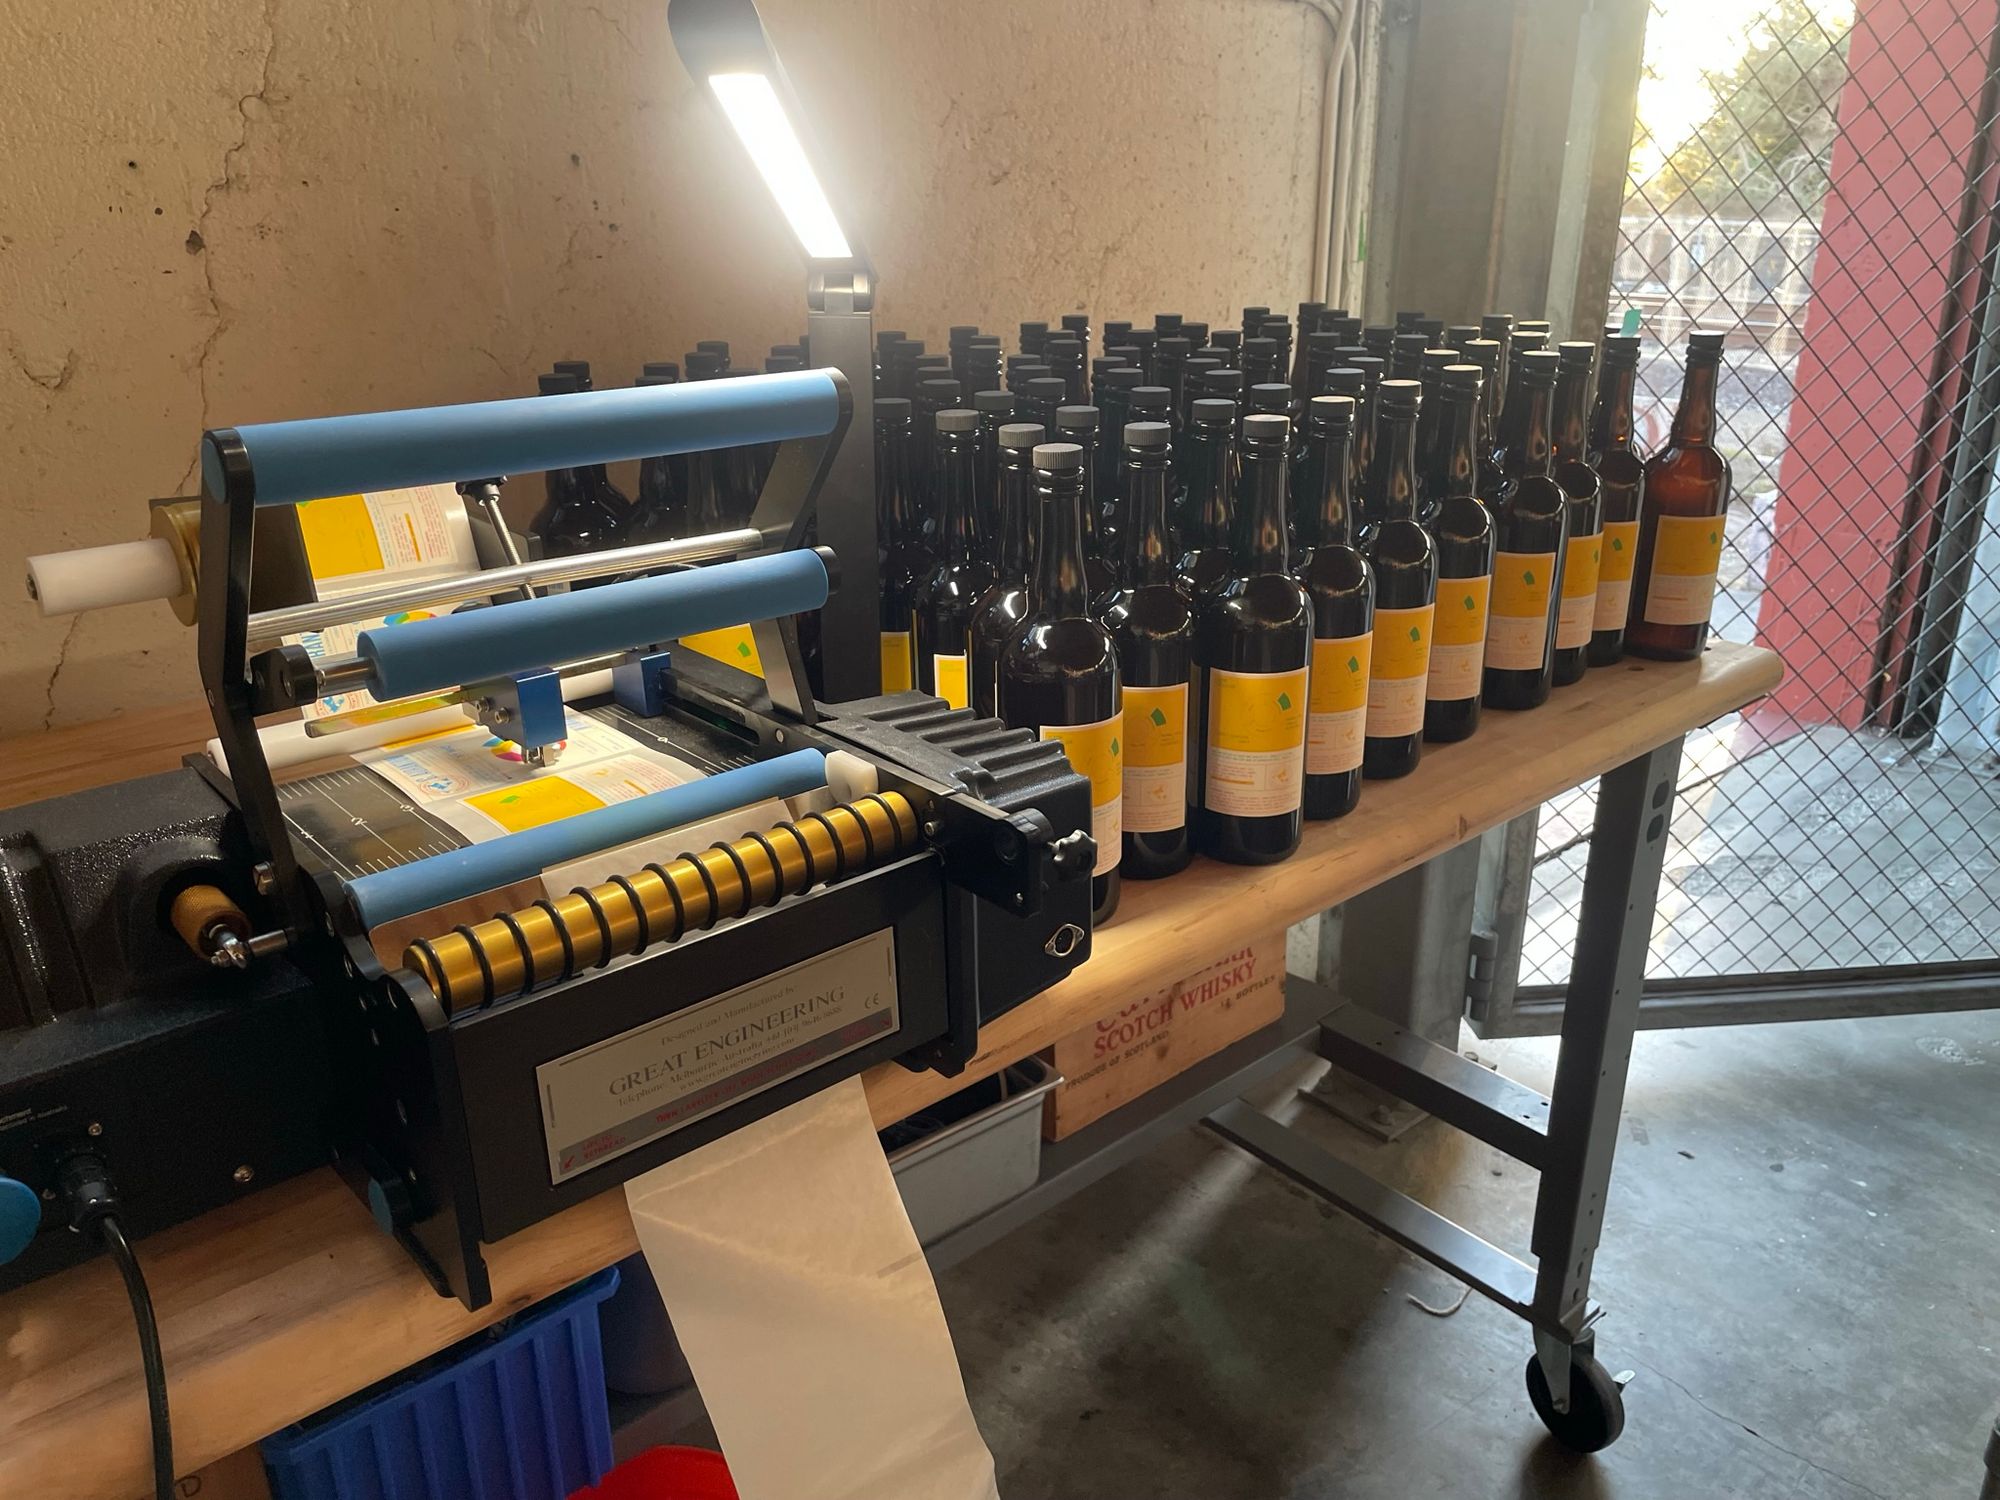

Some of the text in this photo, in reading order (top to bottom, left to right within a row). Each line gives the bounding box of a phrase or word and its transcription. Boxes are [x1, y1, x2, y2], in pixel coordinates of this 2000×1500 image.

[864, 992, 879, 1010] CE
[1093, 1004, 1174, 1059] SCOTCH
[1179, 958, 1256, 1012] WHISKY
[1236, 975, 1275, 1000] BOTTLES
[609, 1051, 688, 1096] GREAT
[695, 987, 845, 1060] ENGINEERING
[662, 1023, 702, 1046] Designed
[704, 1015, 721, 1026] and
[724, 991, 784, 1019] Manufactured
[670, 1058, 720, 1083] Melbourne
[725, 1039, 763, 1061] Australia
[1066, 1031, 1170, 1090] PRODUCE OF SCOTLAND
